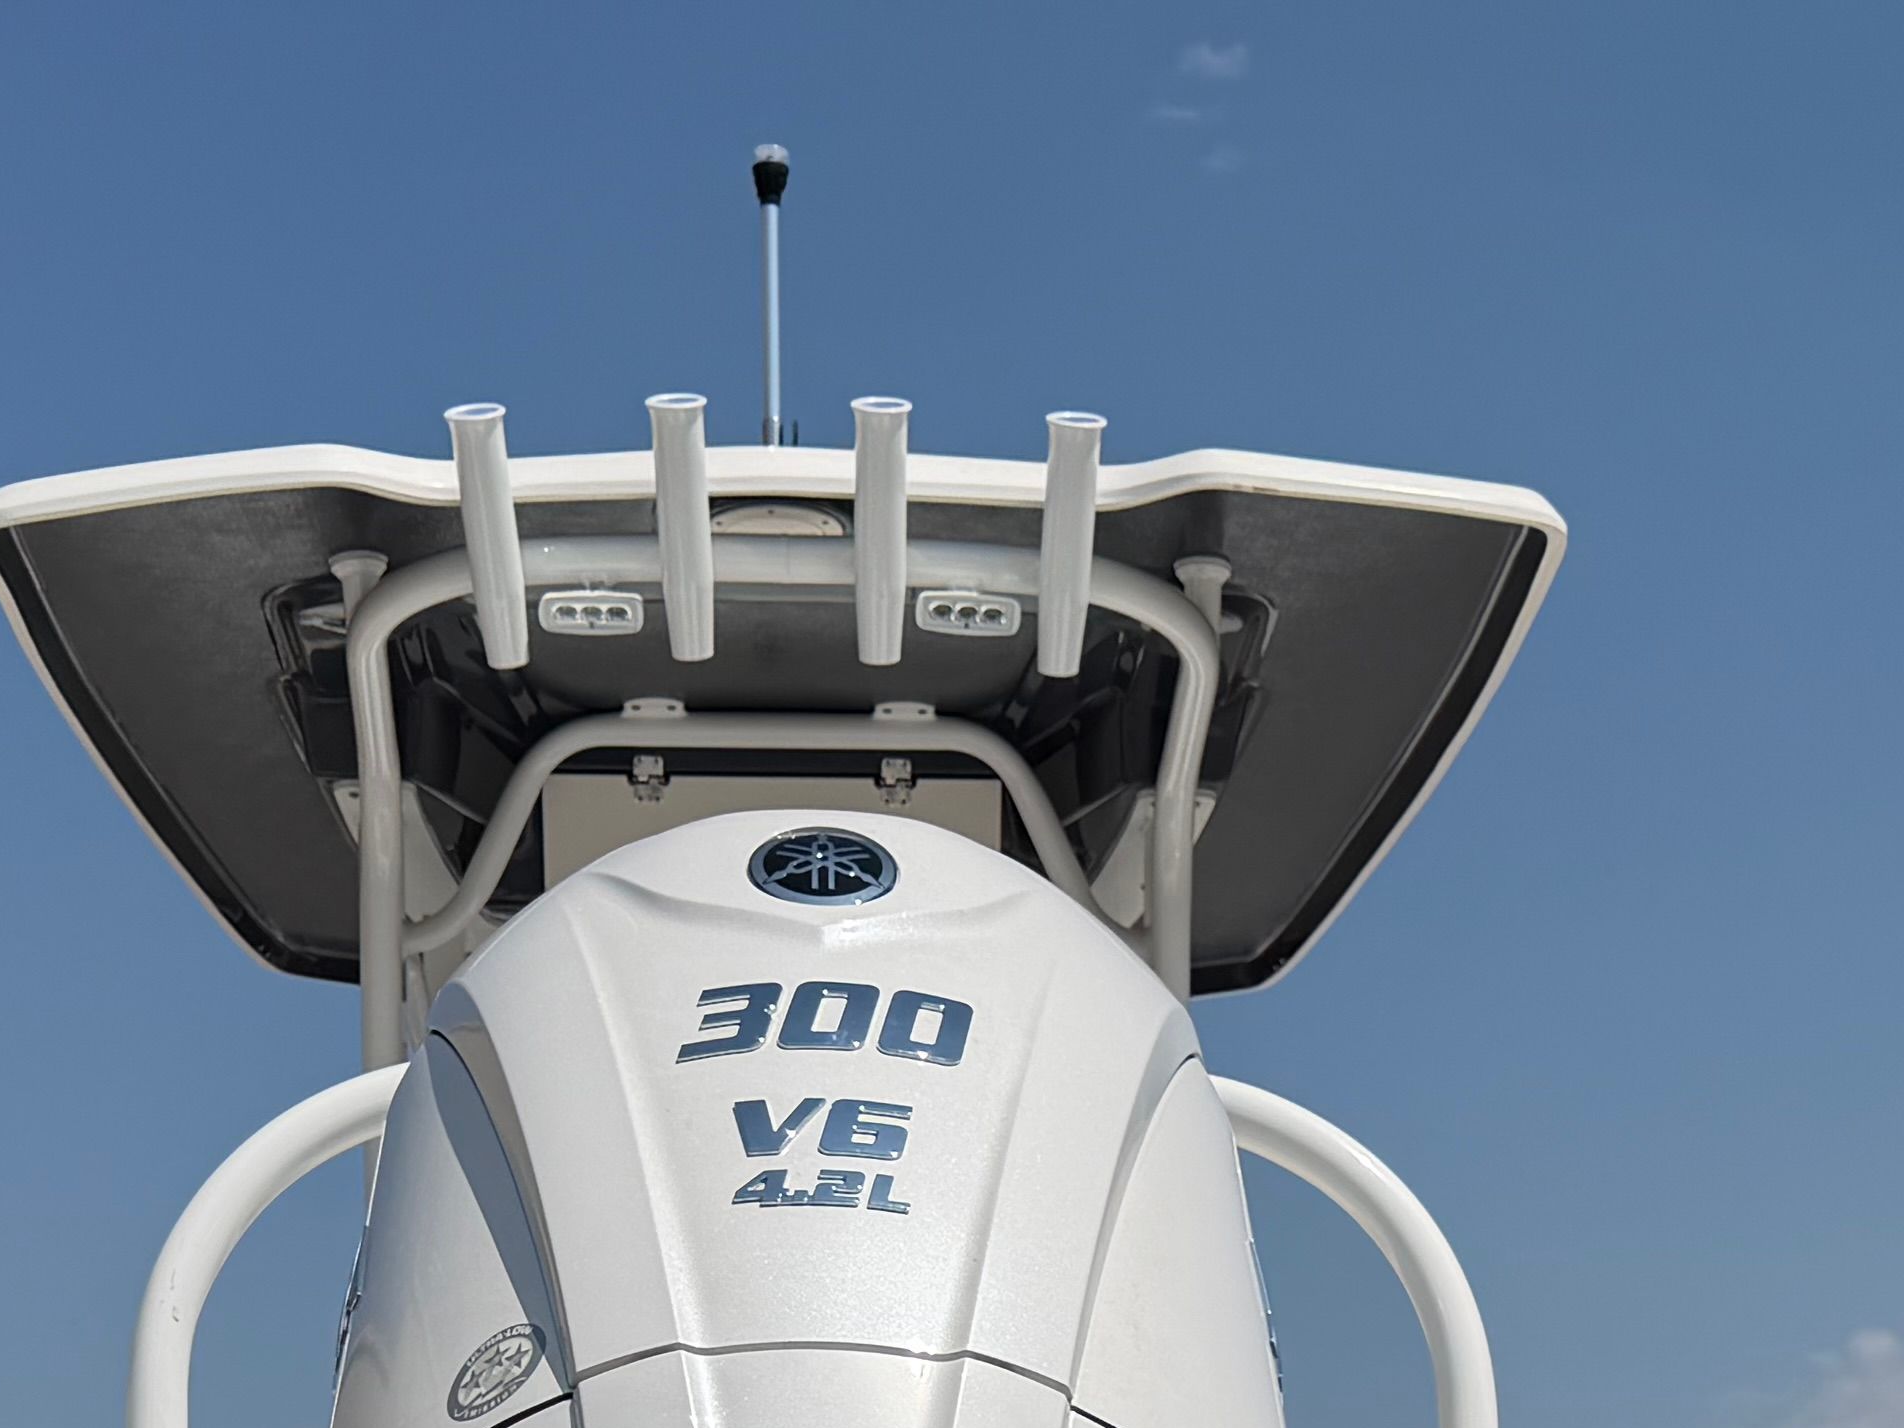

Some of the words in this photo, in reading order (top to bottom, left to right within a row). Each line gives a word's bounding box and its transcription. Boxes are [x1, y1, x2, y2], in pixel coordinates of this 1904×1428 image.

[676, 980, 974, 1067] 300
[732, 1098, 913, 1160] V6
[730, 1168, 911, 1215] 4.2L
